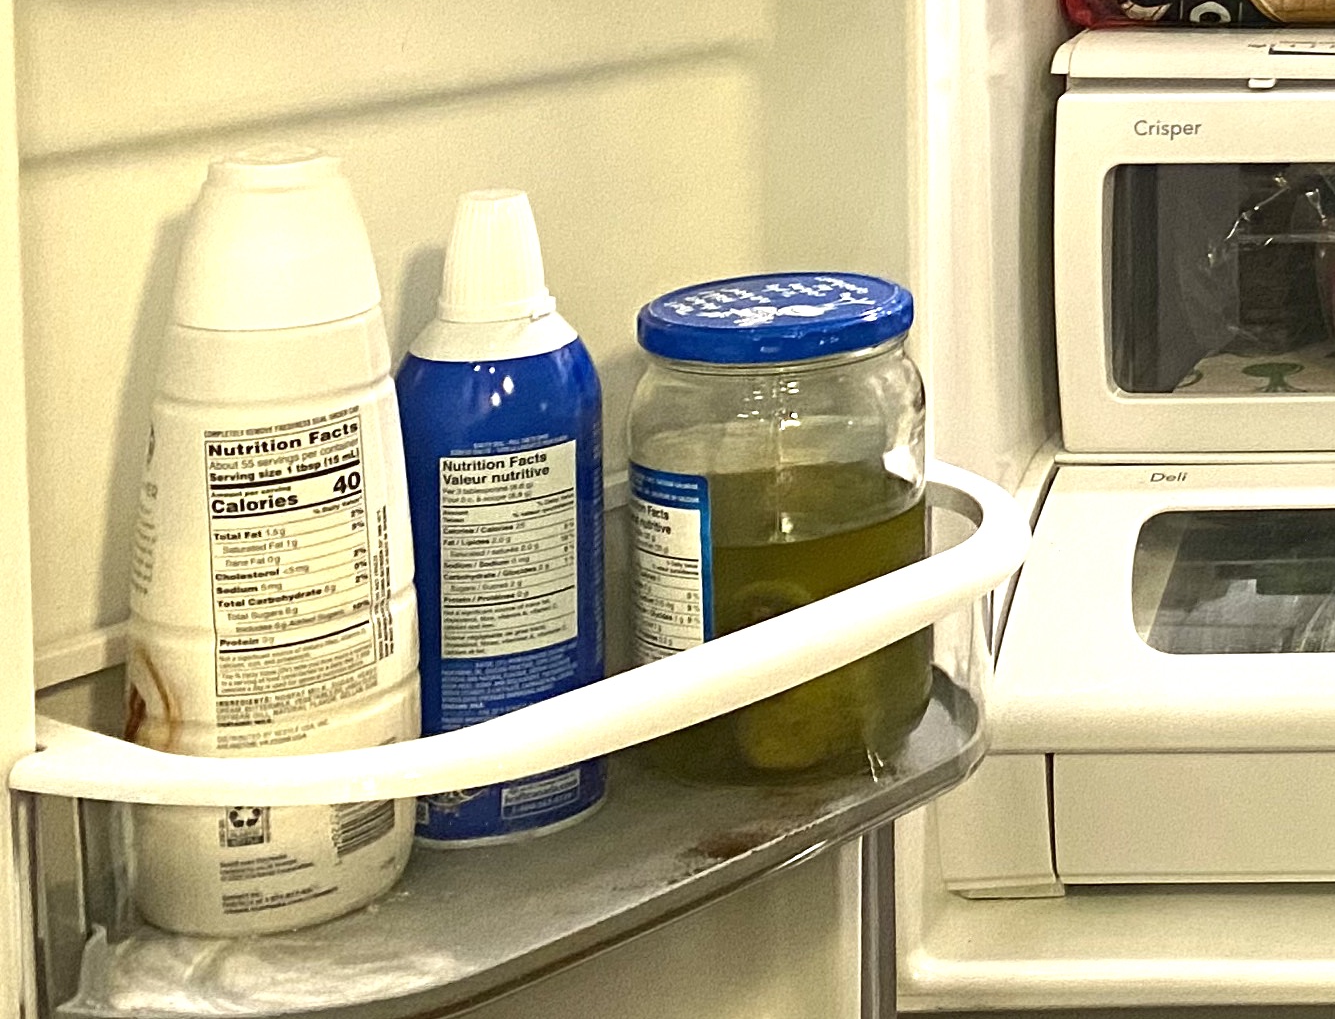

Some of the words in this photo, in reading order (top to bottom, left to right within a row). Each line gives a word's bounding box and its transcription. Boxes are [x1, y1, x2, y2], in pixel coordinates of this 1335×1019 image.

[1134, 120, 1202, 141] Crisper
[208, 438, 301, 457] Nutrition
[309, 423, 358, 445] Facts
[209, 461, 238, 470] About
[241, 460, 255, 468] 55
[257, 454, 300, 467] servings
[303, 449, 318, 461] per
[319, 439, 359, 455] container
[210, 471, 255, 482] Serving
[259, 469, 282, 478] size
[296, 461, 321, 473] tbsp
[324, 454, 339, 466] (15
[342, 448, 360, 460] mL)
[442, 460, 505, 472] Nutrition
[509, 452, 547, 468] Facts
[442, 474, 488, 486] Valeur
[491, 466, 550, 483] nutritive
[1150, 472, 1188, 482] Deli
[211, 494, 299, 514] Calories
[333, 471, 361, 494] 40
[261, 486, 291, 495] serving
[647, 505, 669, 521] Facts
[214, 533, 241, 541] Total
[244, 531, 263, 539] Fat
[480, 525, 514, 534] Calories
[223, 544, 266, 555] Saturated
[269, 541, 284, 550] Fat
[215, 569, 279, 582] Cholesterol
[216, 585, 258, 595] Sodium
[218, 599, 245, 608] Total
[248, 587, 323, 606] Carbohydrate
[228, 613, 249, 621] Total
[251, 608, 283, 620] Sugars
[289, 616, 316, 626] Added
[220, 637, 259, 647] Protein
